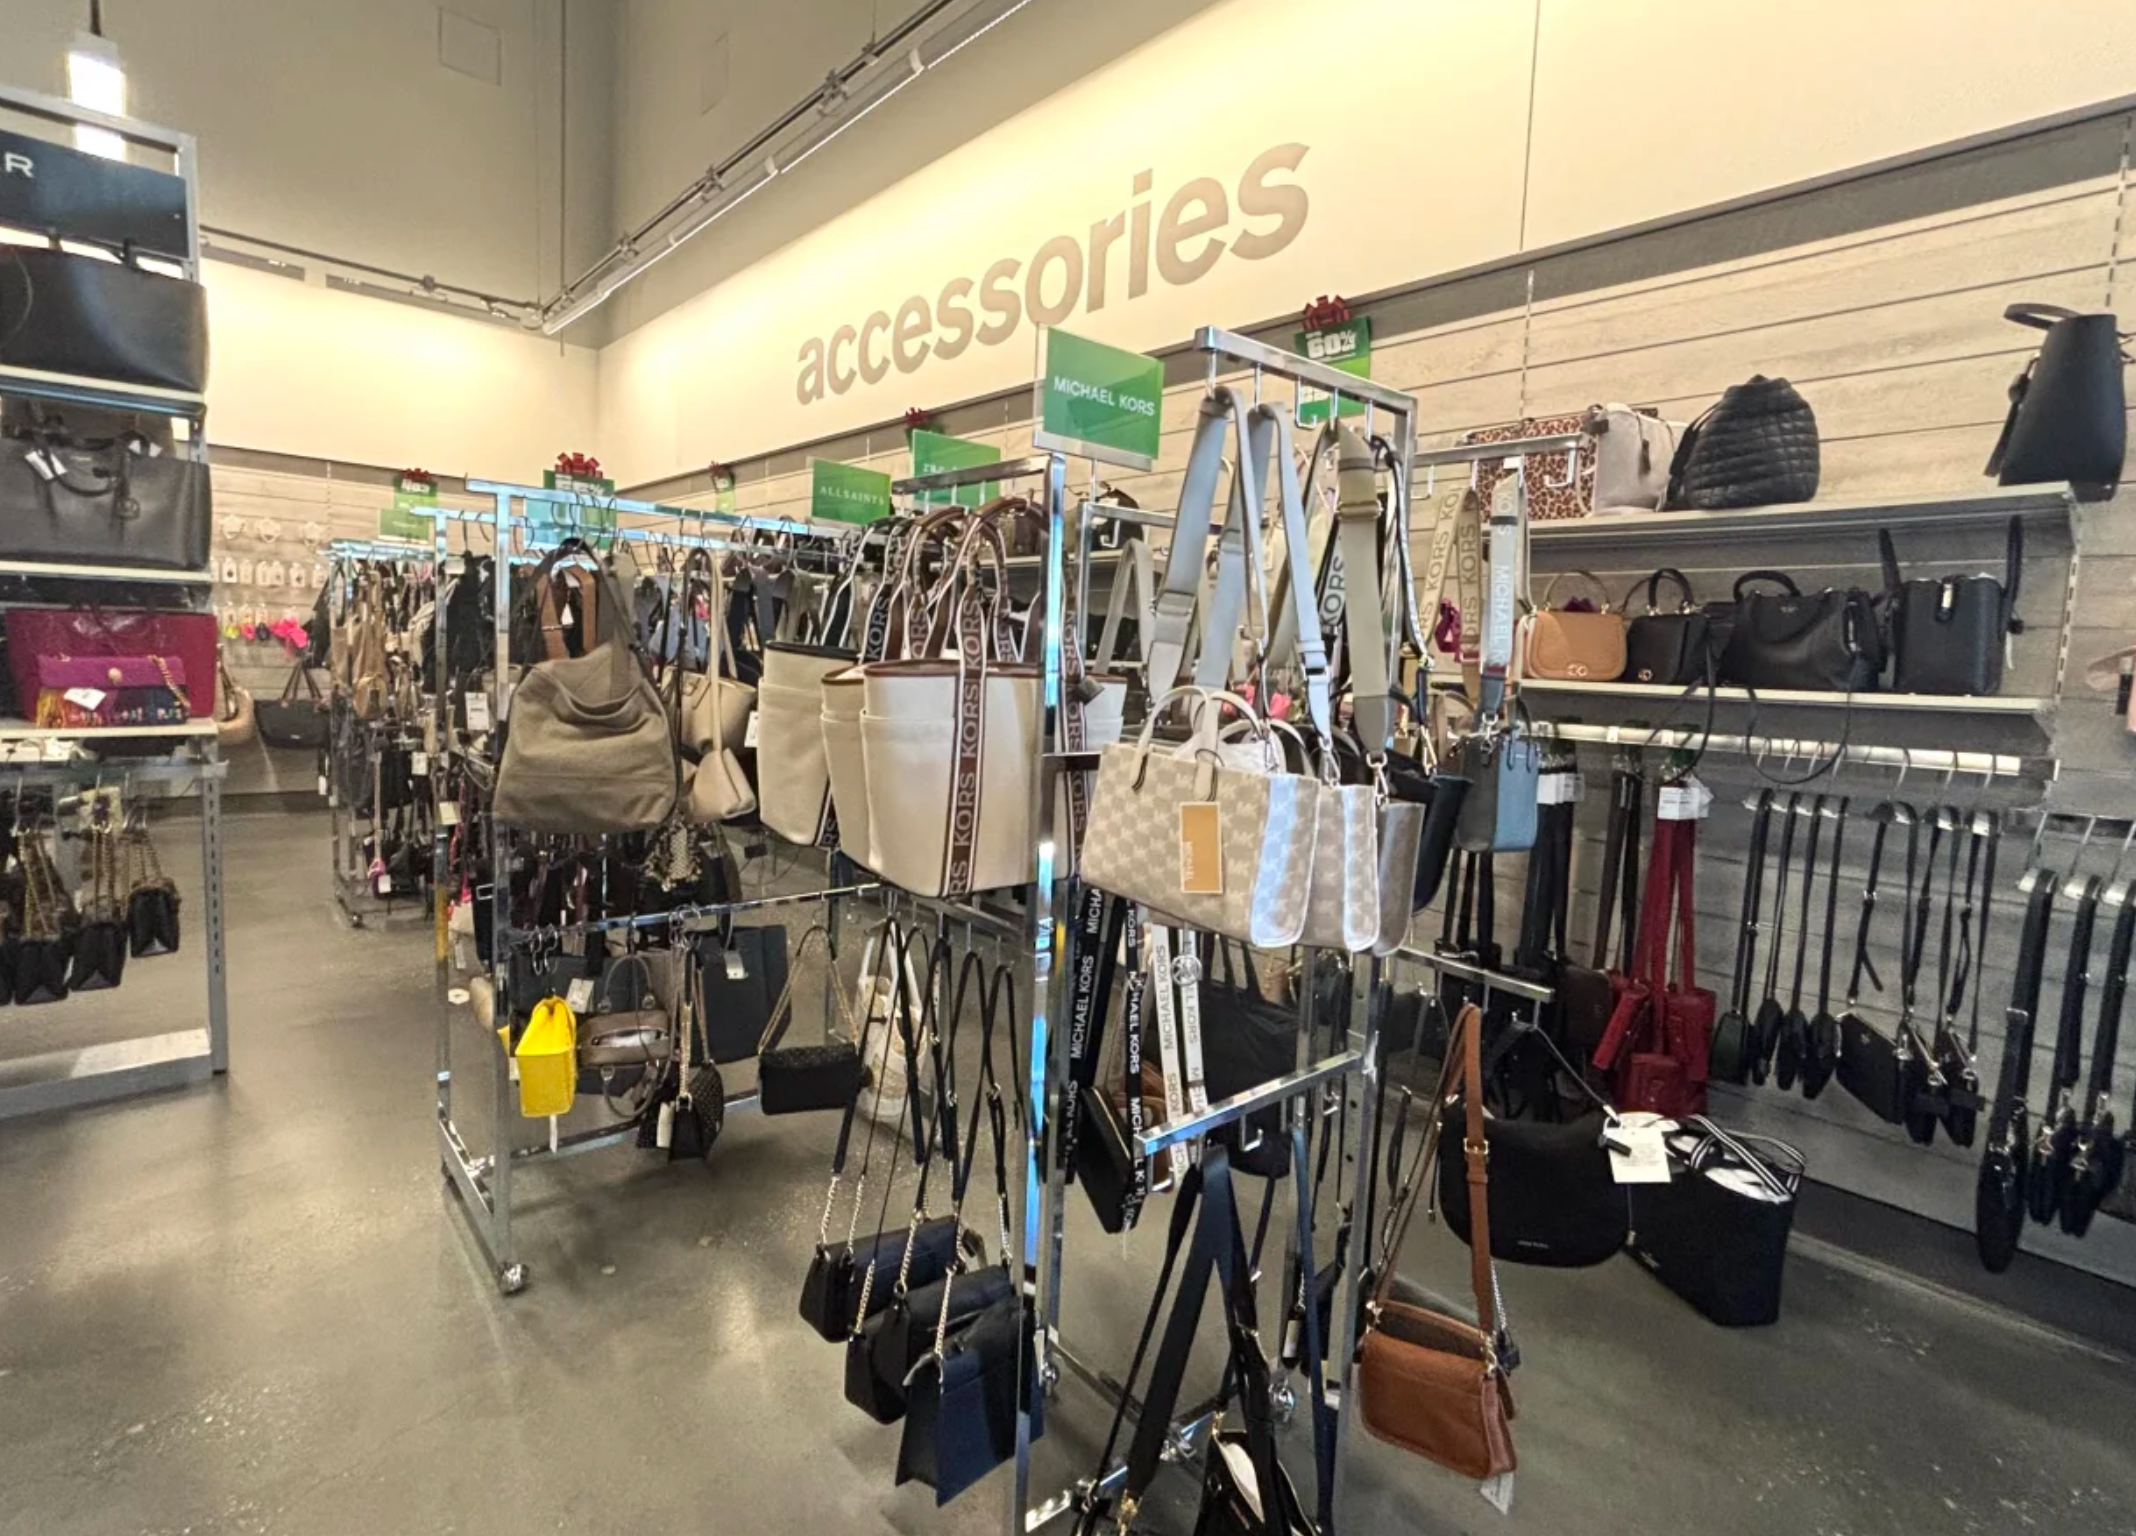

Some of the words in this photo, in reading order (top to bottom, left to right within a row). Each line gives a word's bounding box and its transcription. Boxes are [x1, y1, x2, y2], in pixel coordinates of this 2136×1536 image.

[796, 142, 1311, 405] accessories
[1053, 375, 1115, 407] MICHAEL
[1119, 393, 1155, 417] KORS
[820, 485, 884, 506] ALLSAINTS
[1426, 531, 1448, 591] KORS
[1462, 524, 1476, 585] KORS
[867, 595, 892, 659] KORS
[963, 600, 981, 669] KORS
[961, 684, 979, 759] KORS
[953, 772, 976, 846] KORS
[1127, 910, 1136, 948] KORS
[1078, 955, 1094, 992] KORS
[1155, 945, 1171, 983] KORS
[1070, 996, 1088, 1059] MICHAEL
[1160, 986, 1175, 1051] MICHAEL
[1129, 1034, 1141, 1074] KORS
[1166, 1073, 1179, 1113] KORS
